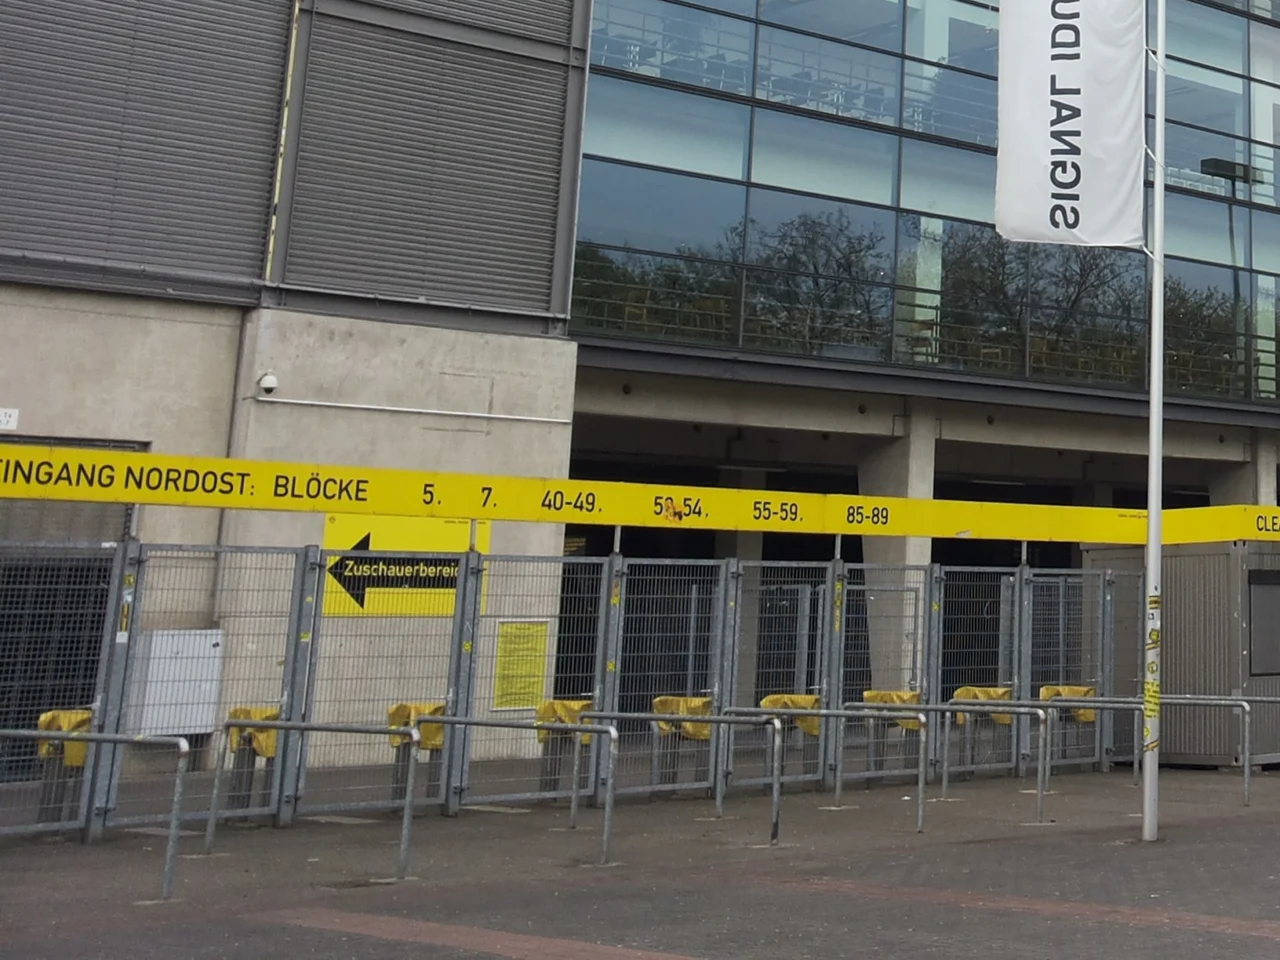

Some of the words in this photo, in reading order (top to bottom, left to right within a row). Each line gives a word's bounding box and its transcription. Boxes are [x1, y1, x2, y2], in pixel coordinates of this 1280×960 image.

[0, 458, 116, 488] INGANG
[124, 465, 256, 497] NORDOST:
[273, 472, 370, 503] BLÖCKE
[846, 505, 889, 526] 85-89
